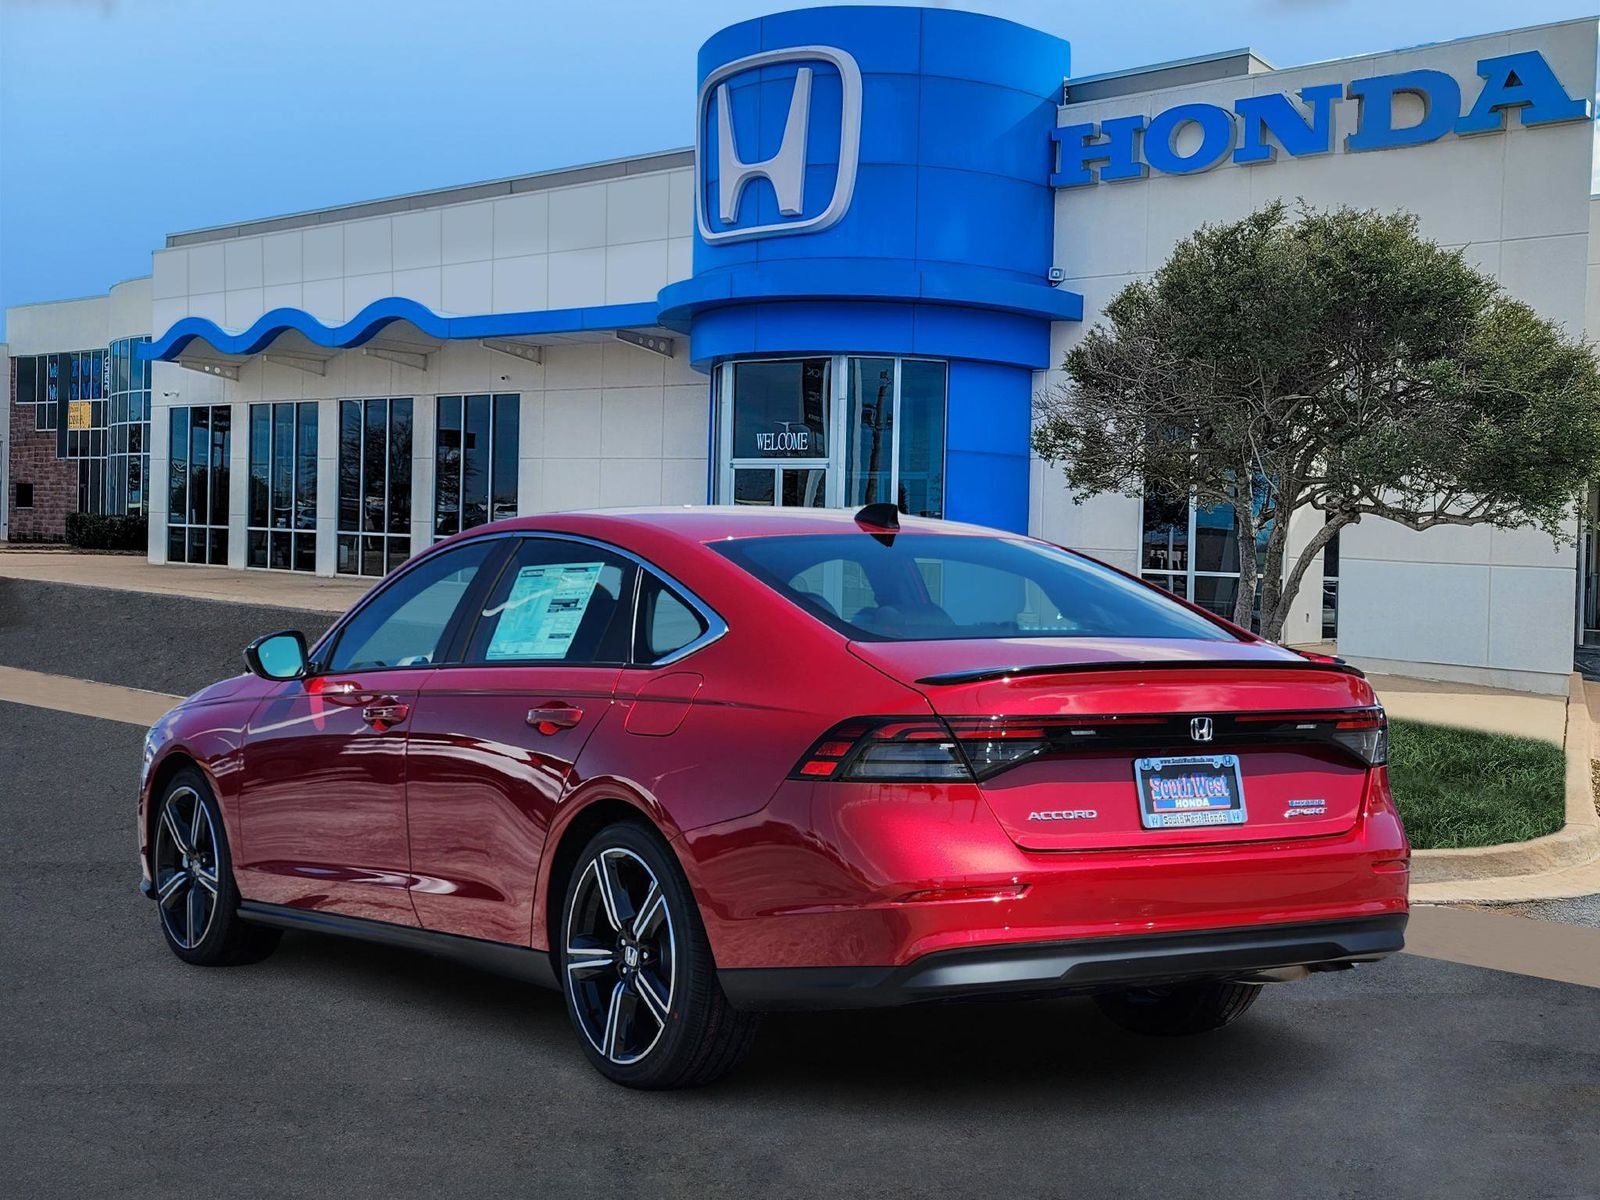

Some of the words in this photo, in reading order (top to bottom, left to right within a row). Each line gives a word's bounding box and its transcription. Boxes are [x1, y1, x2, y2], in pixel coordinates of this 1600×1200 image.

[1051, 50, 1590, 188] HONDA
[756, 432, 808, 450] WELCOME
[1150, 773, 1230, 800] SouthWest
[1175, 798, 1210, 808] HONDA
[1027, 809, 1098, 821] ACCORD
[1163, 814, 1202, 825] SouthWest
[1203, 812, 1228, 823] Honda
